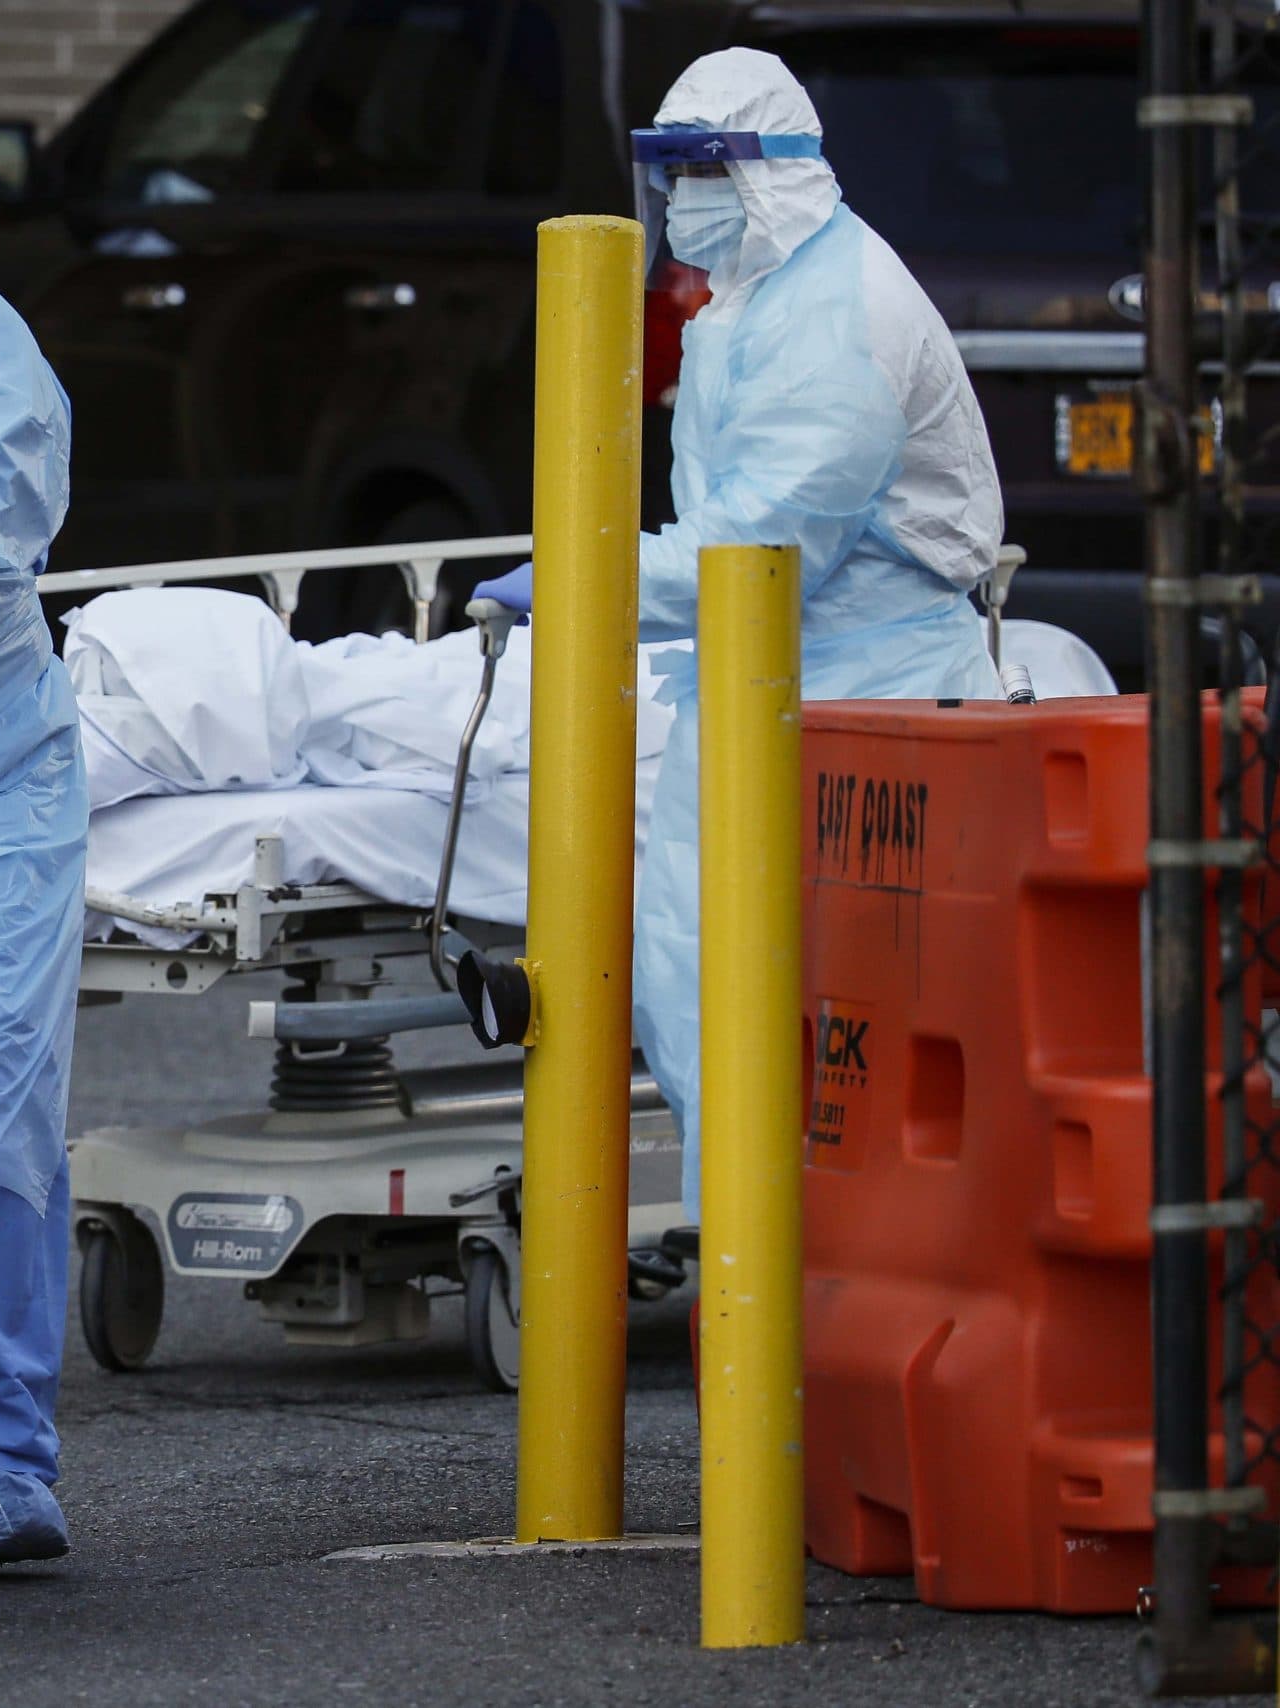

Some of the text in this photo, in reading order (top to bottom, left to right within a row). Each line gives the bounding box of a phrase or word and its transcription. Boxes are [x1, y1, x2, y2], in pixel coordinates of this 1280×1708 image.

[818, 773, 928, 852] EAST COAST
[192, 1240, 263, 1261] Hill-Rom
